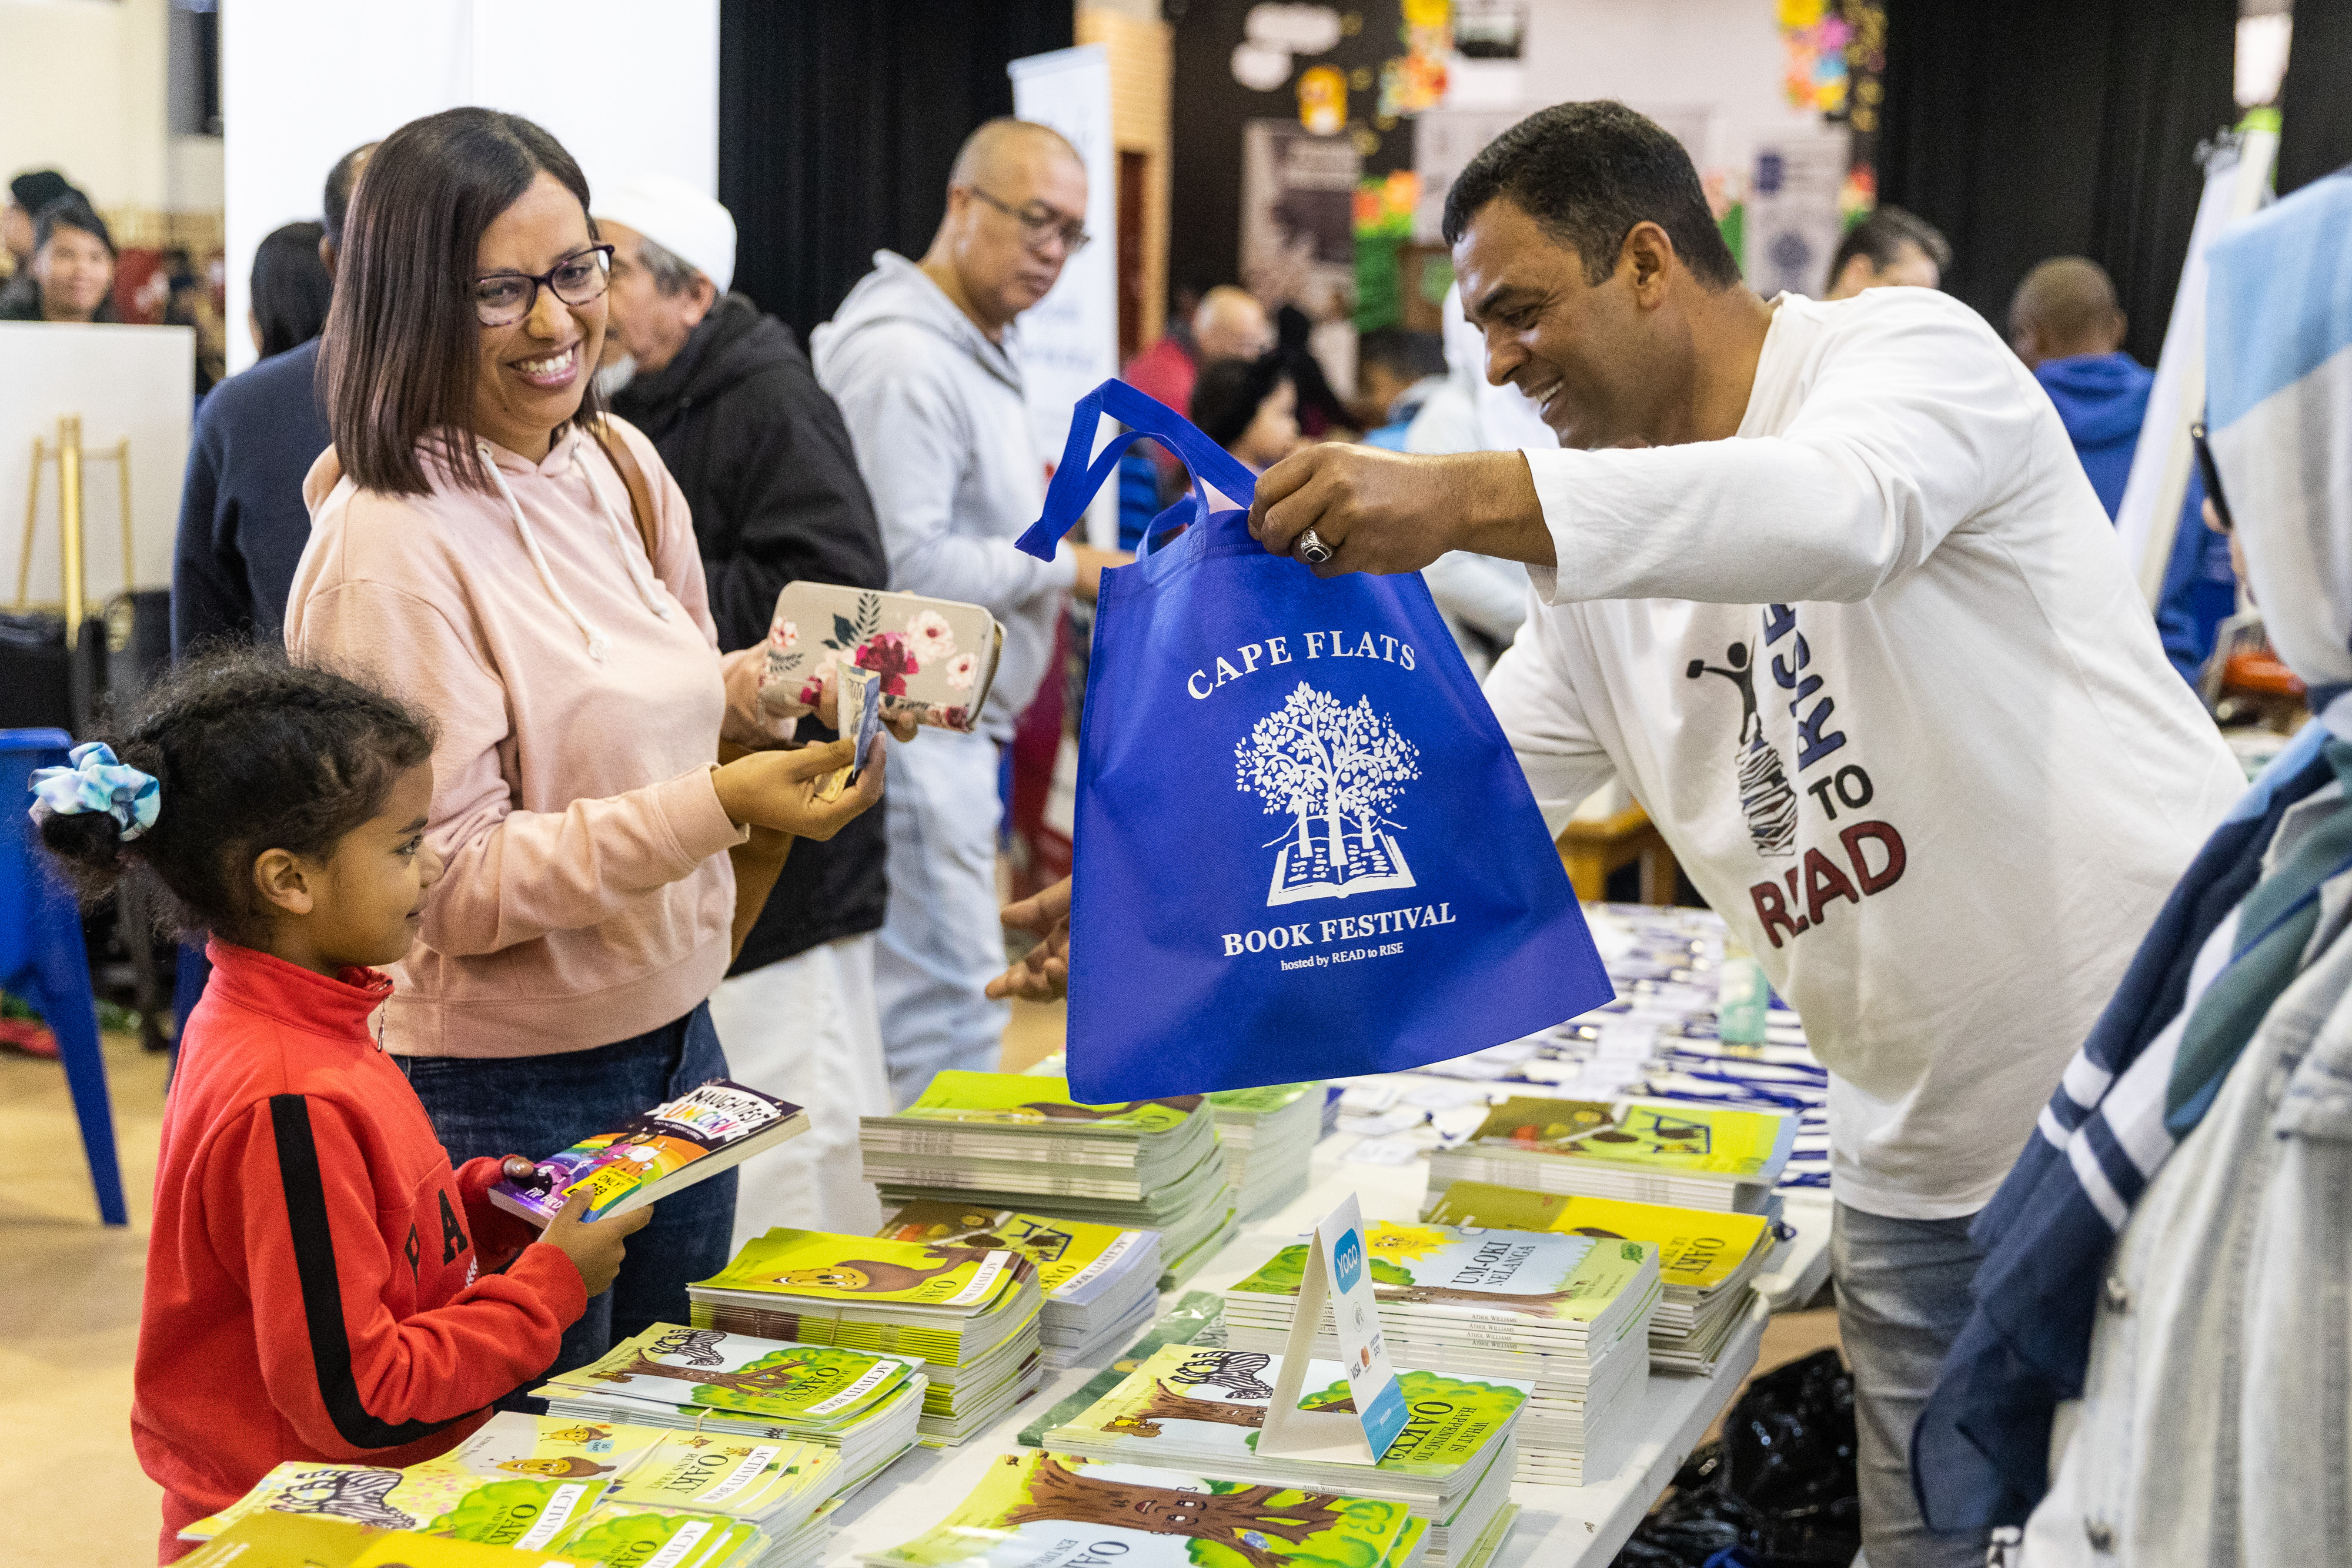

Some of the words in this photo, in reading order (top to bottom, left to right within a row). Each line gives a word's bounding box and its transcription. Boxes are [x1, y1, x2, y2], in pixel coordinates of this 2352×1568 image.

[1187, 636, 1292, 700] CAPE
[1304, 630, 1415, 670] FLATS
[1808, 764, 1873, 820] TO
[1221, 922, 1313, 957] BOOK
[1319, 902, 1456, 943] FESTIVAL
[1281, 958, 1314, 971] hosted
[1315, 955, 1329, 969] by
[1332, 948, 1365, 964] READ
[1367, 948, 1378, 958] to
[1379, 942, 1404, 956] RISE
[664, 1103, 740, 1135] UNICORN
[598, 1175, 625, 1189] ONLY!
[524, 1186, 544, 1198] PIP
[540, 1193, 564, 1209] BIRD
[1451, 1241, 1512, 1284] UM-OKI
[1484, 1245, 1536, 1286] NELANGA
[1469, 1322, 1487, 1331] ATHOL
[1488, 1324, 1515, 1333] WILLIAMS
[1471, 1313, 1489, 1322] ATHOL
[1490, 1315, 1518, 1323] WILLIAMS
[1466, 1331, 1485, 1340] ATHOL
[1485, 1333, 1512, 1341] WILLIAMS
[1471, 1339, 1490, 1348] ATHOL
[1491, 1341, 1518, 1349] WILLIAMS
[843, 1364, 890, 1398] ACTIVITY
[1350, 1361, 1362, 1380] VISA
[783, 1367, 840, 1402] OAKY?
[807, 1370, 851, 1398] HAPPENING
[830, 1381, 851, 1395] WHAT
[813, 1397, 848, 1412] BOOK
[1424, 1406, 1478, 1450] HAPPENING
[1457, 1422, 1489, 1444] WHAT
[1413, 1452, 1435, 1460] TO
[1448, 1444, 1468, 1452] IS
[672, 1452, 699, 1471] RUNS
[727, 1449, 770, 1488] ACTIVITY
[646, 1476, 673, 1489] RACE
[662, 1454, 729, 1494] OAKY
[701, 1487, 735, 1501] BOOK
[532, 1488, 576, 1537] ACTIVITY
